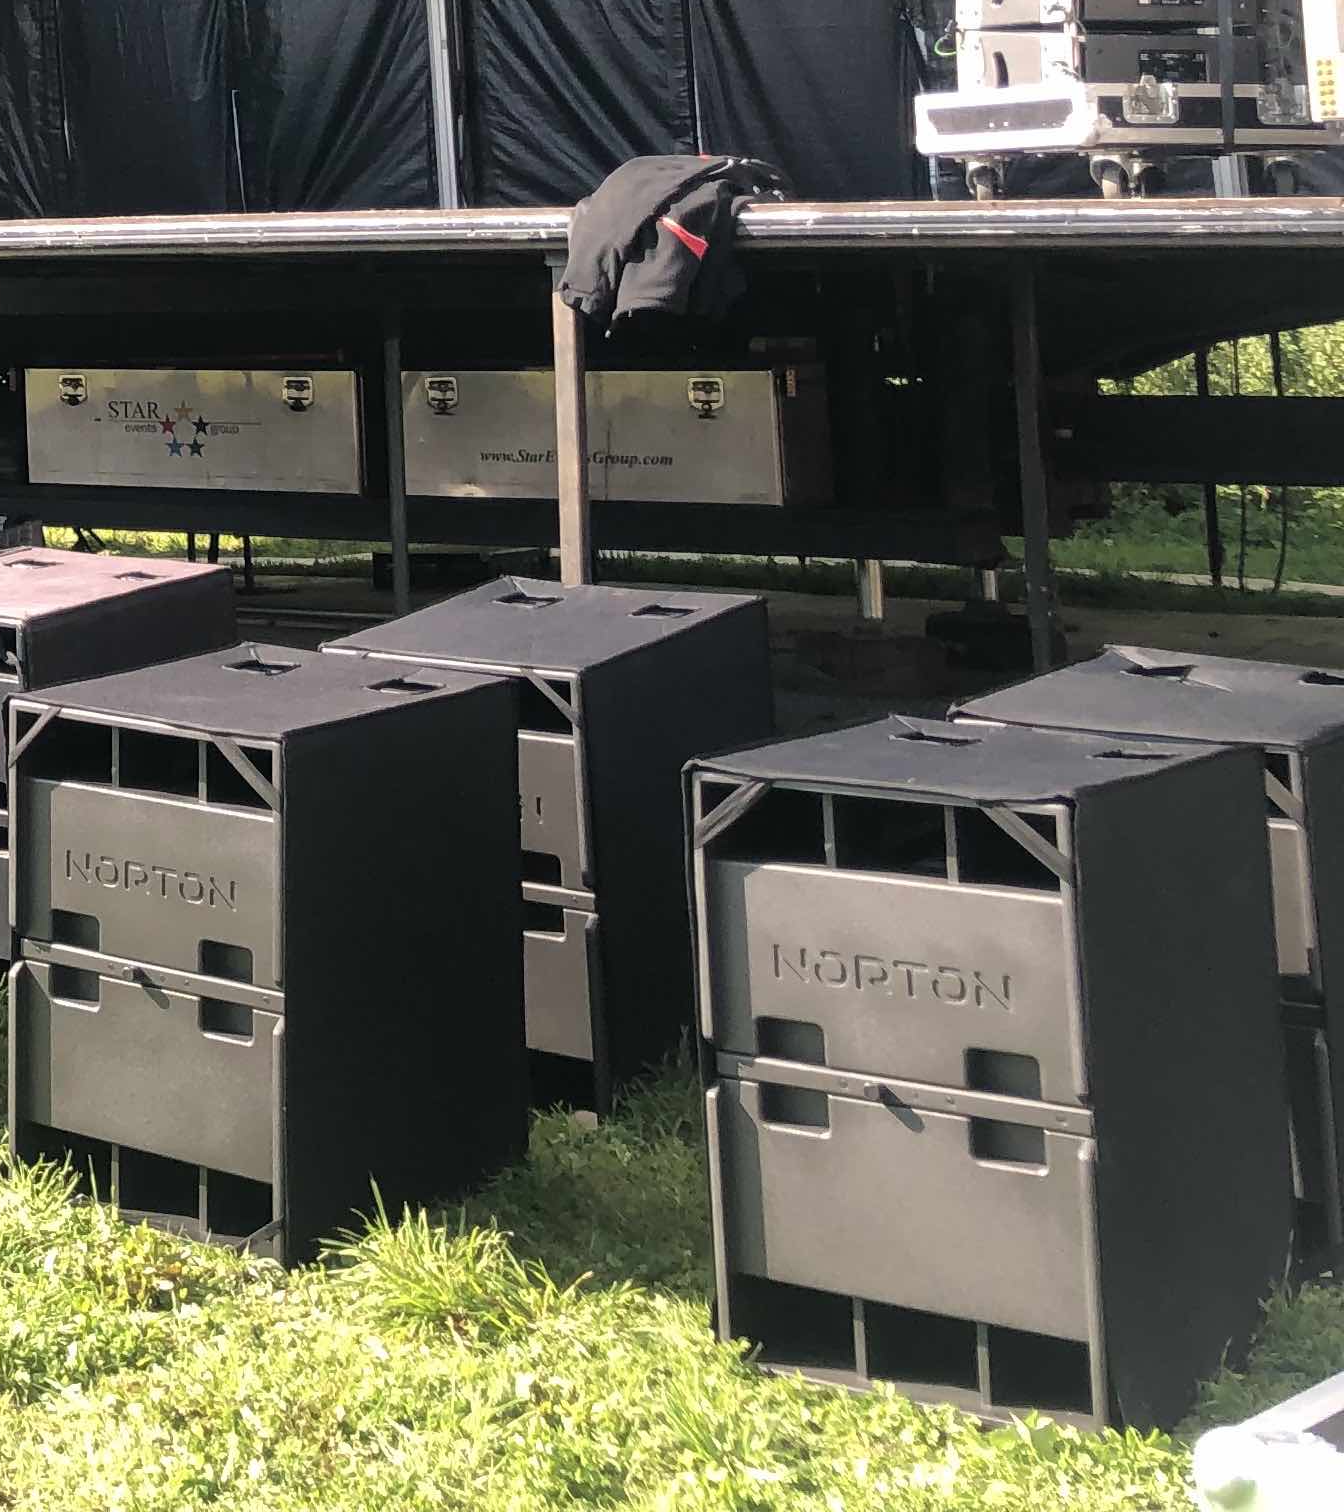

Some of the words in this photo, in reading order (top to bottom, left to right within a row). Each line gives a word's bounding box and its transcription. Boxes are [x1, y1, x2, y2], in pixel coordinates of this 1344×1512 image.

[108, 400, 160, 419] STAR
[125, 423, 158, 433] events
[210, 424, 240, 436] group
[65, 849, 238, 913] NORTON
[772, 943, 1014, 1013] NORTON
